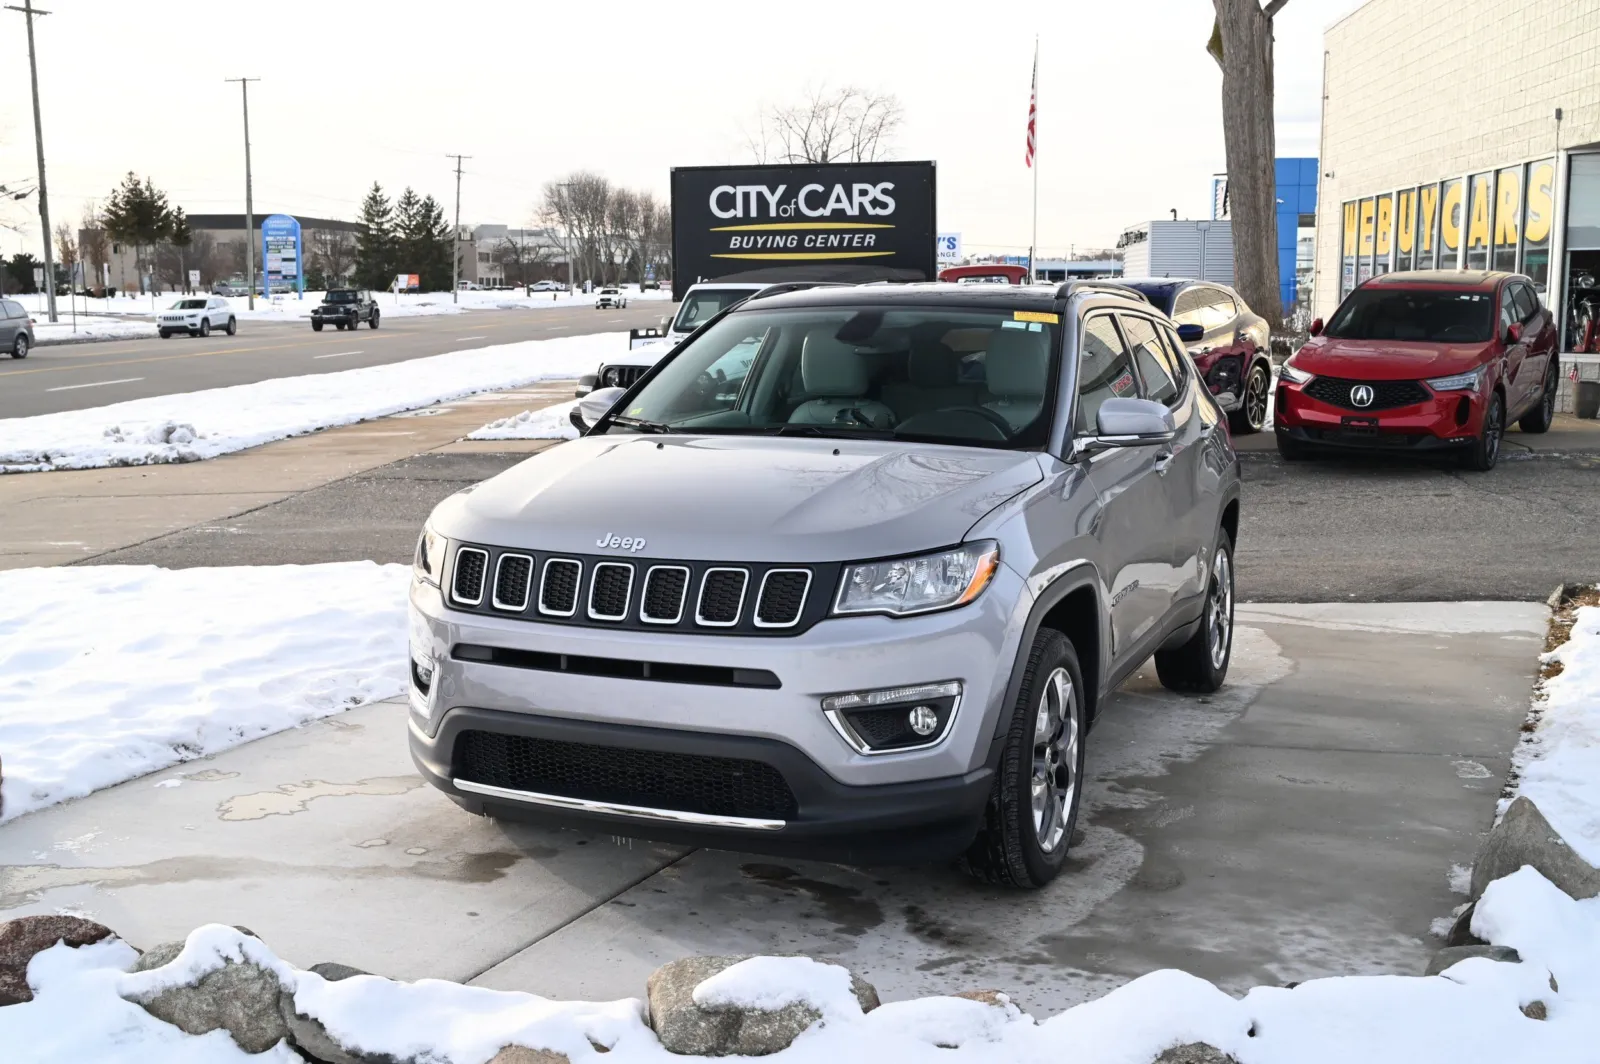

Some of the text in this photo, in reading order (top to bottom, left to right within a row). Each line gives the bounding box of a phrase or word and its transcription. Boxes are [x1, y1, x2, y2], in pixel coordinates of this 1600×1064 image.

[709, 182, 896, 219] CITY of CARS
[1441, 164, 1553, 248] CARS
[729, 233, 876, 249] BUYING CENTER
[595, 532, 646, 553] Jeep
